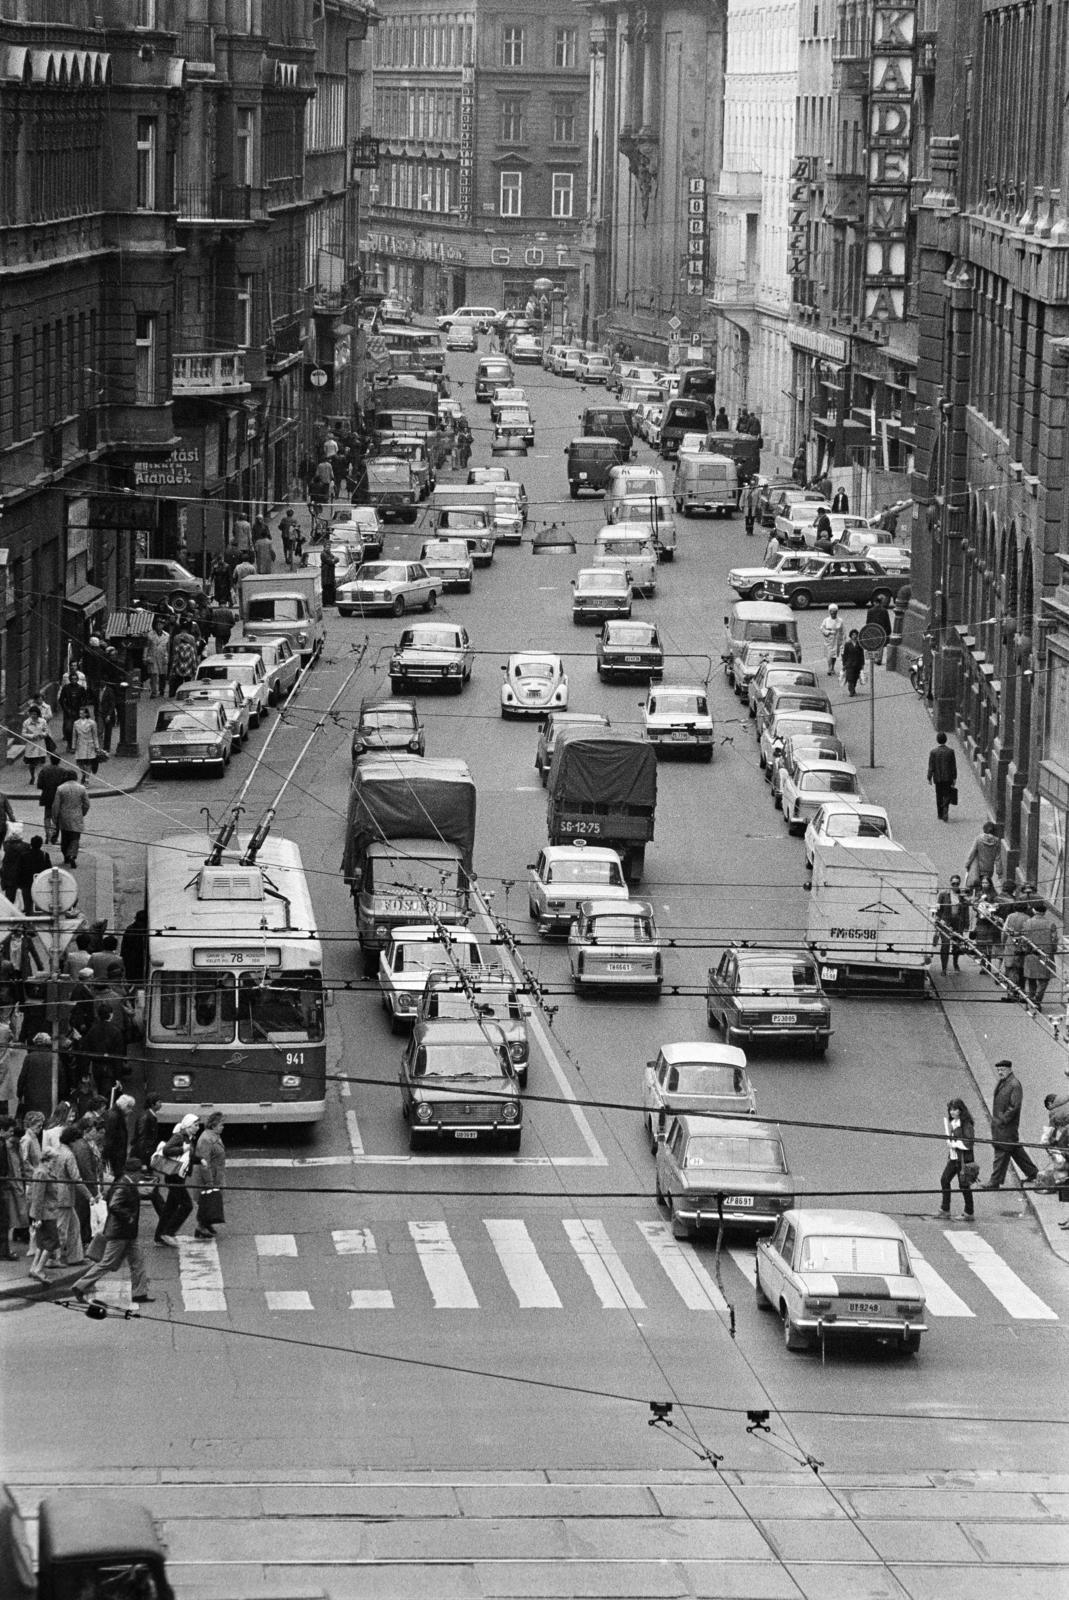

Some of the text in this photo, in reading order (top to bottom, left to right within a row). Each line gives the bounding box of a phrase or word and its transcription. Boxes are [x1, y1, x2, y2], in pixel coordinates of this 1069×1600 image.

[789, 161, 810, 273] BETEX
[230, 952, 244, 964] 78
[286, 1052, 304, 1065] 941
